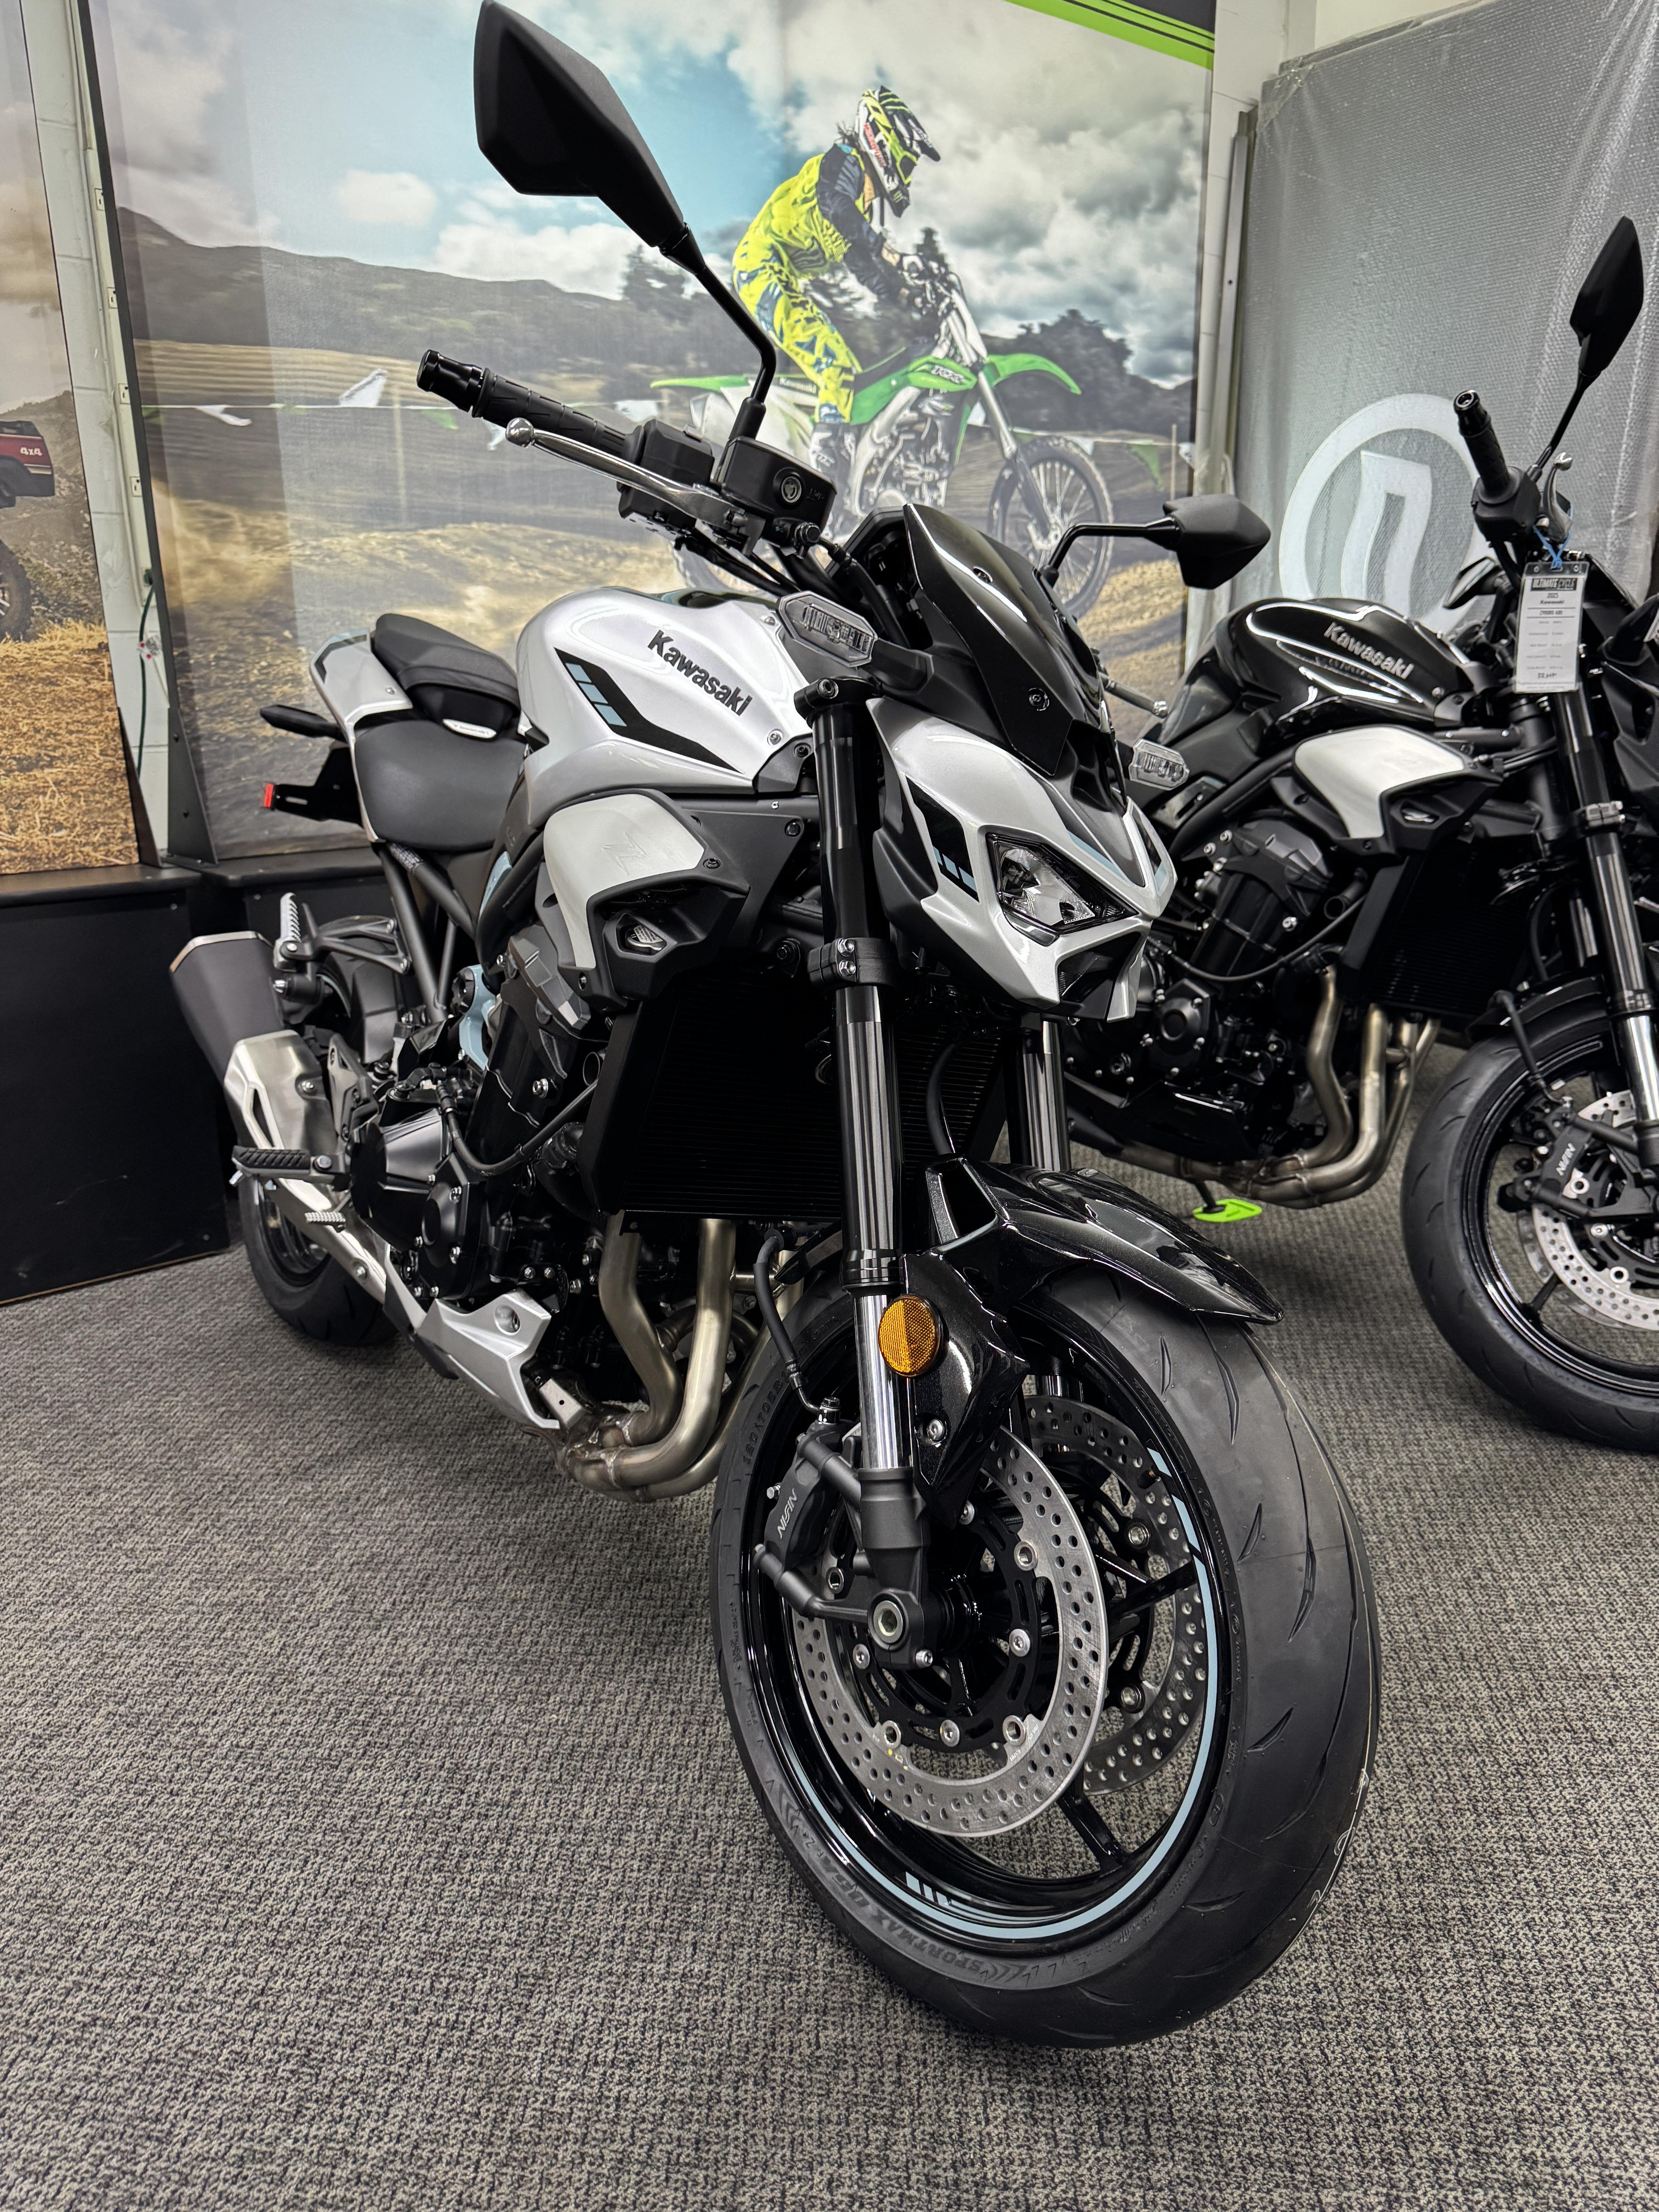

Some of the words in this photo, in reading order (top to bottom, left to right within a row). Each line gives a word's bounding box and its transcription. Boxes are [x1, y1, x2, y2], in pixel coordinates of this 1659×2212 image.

[20, 447, 43, 456] 4x4
[647, 630, 753, 717] Kawasaki
[1323, 621, 1415, 680] Kawasaki
[777, 1488, 798, 1540] NISSIN
[872, 1908, 982, 1974] SPORTMAX
